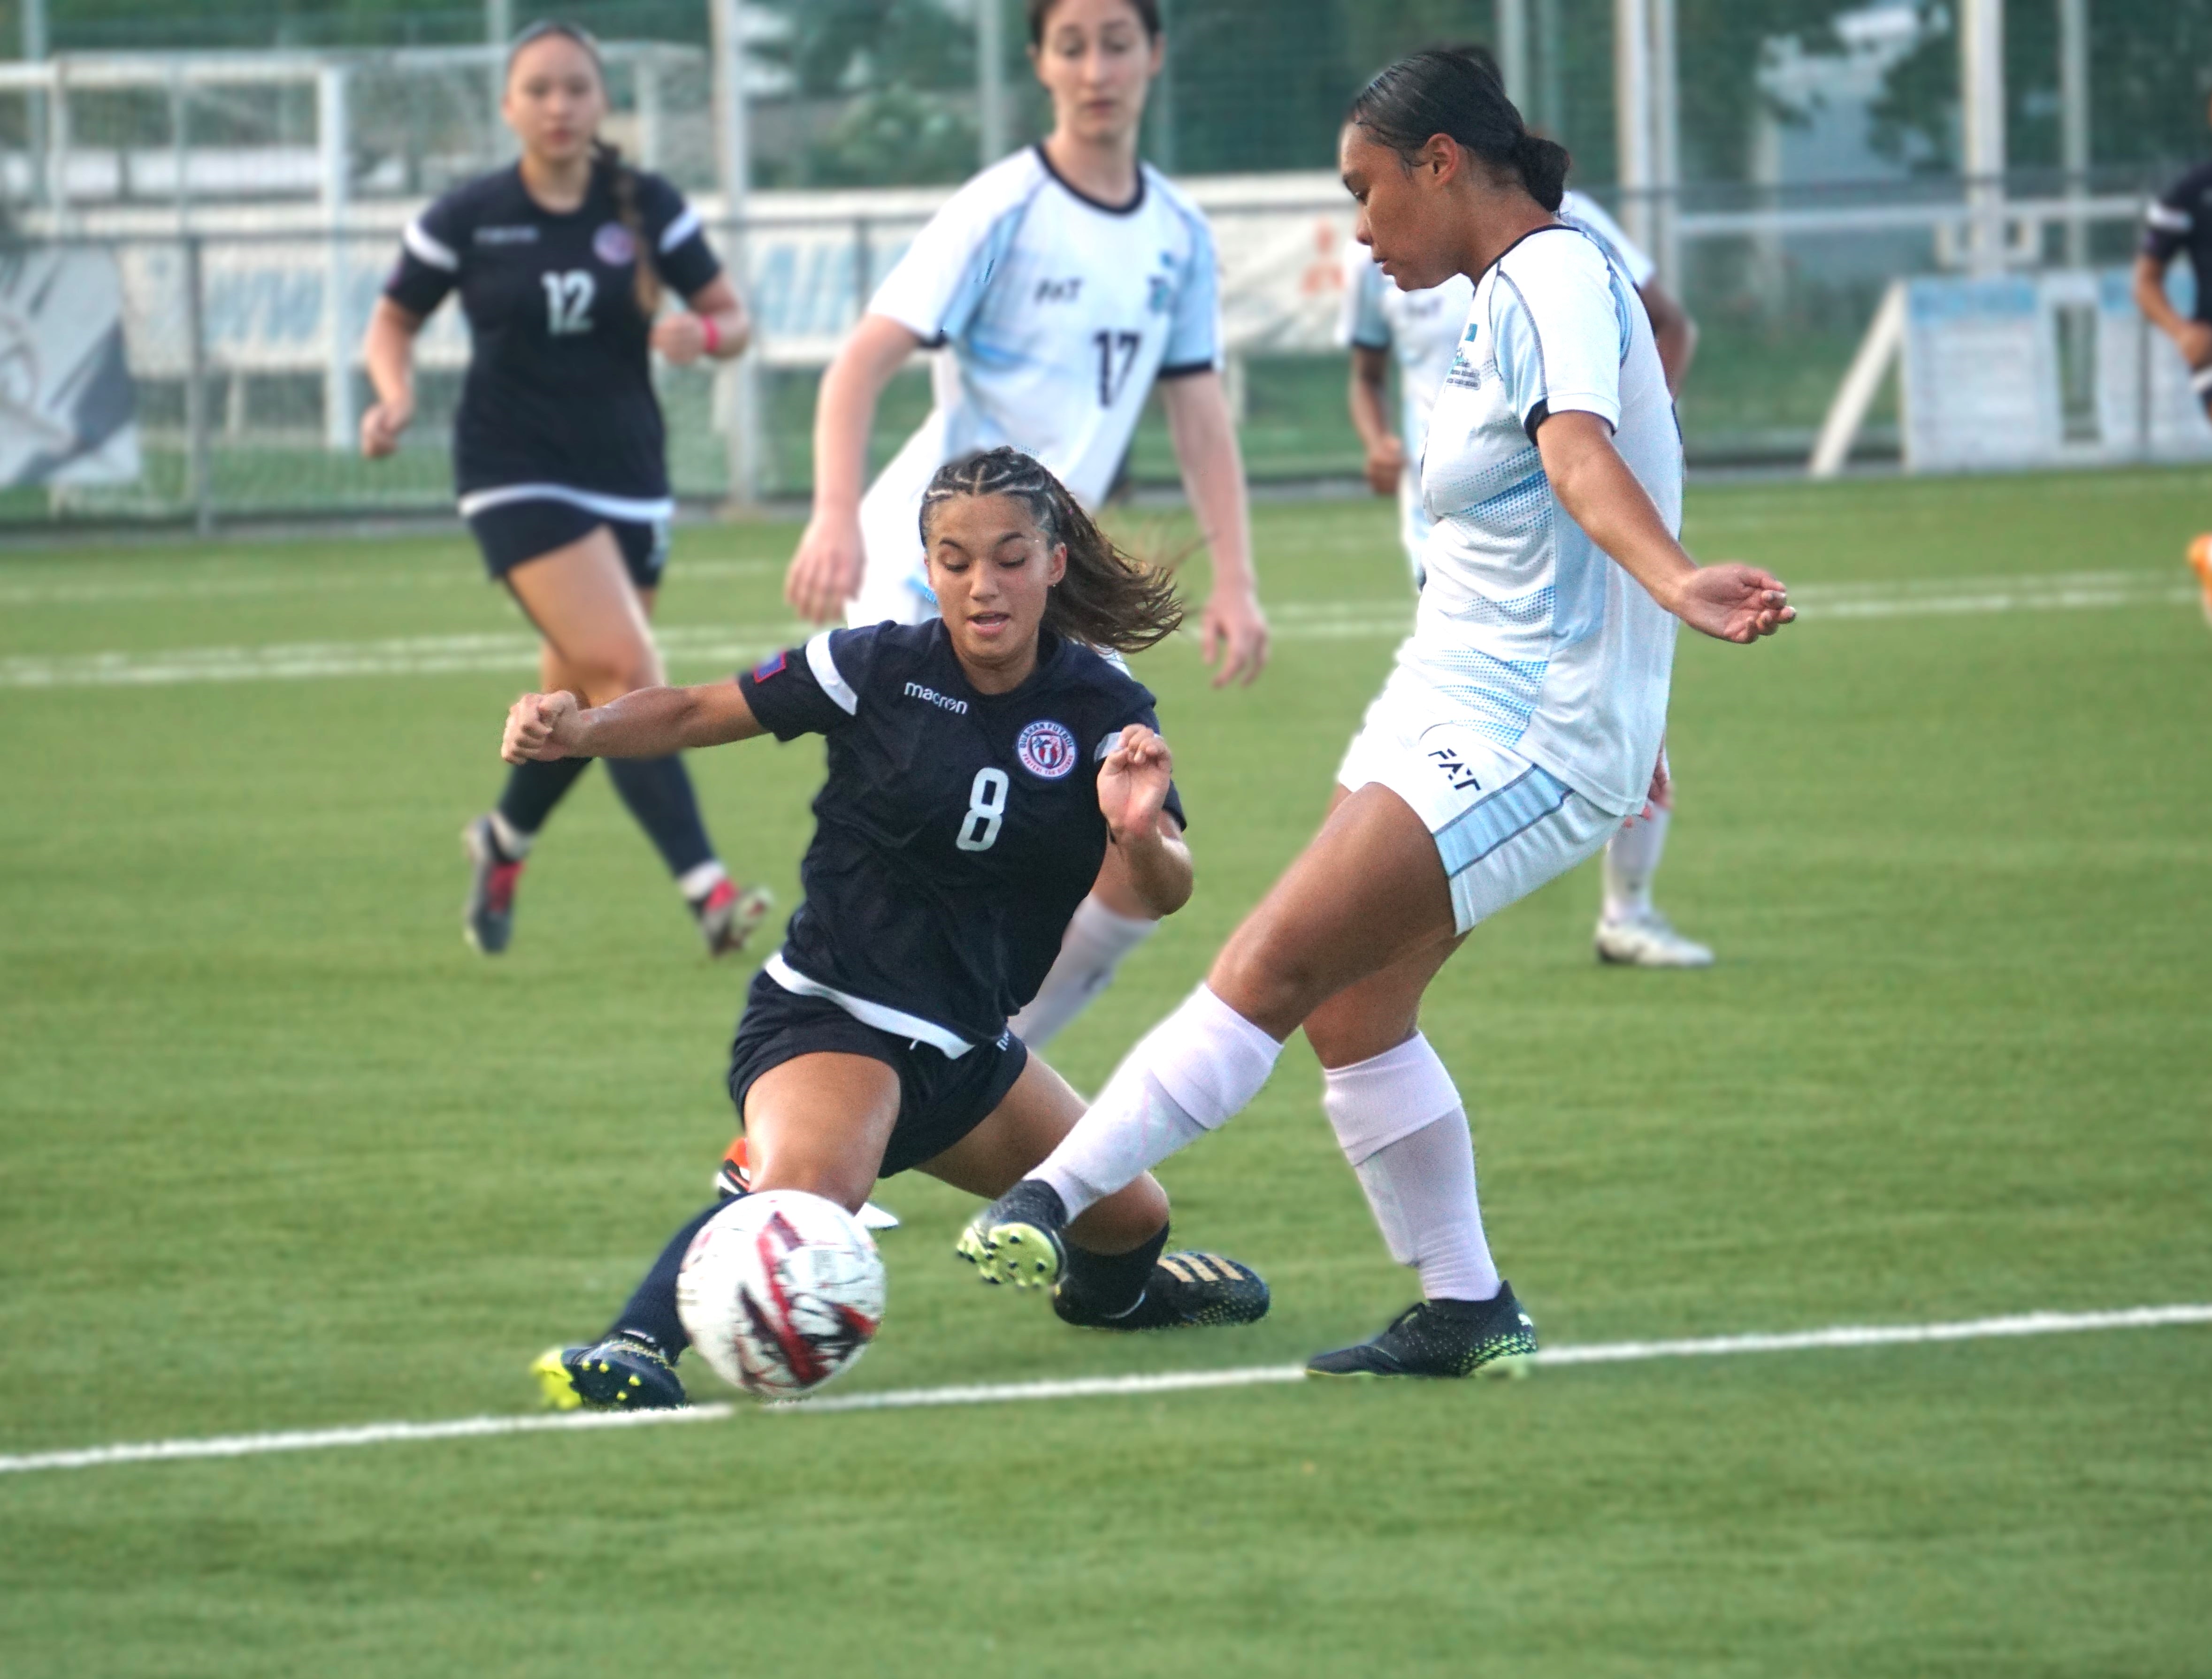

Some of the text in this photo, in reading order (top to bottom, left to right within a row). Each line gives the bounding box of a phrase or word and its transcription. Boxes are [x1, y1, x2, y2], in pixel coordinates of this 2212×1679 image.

[542, 270, 595, 335] 12
[1094, 328, 1142, 408] 17
[904, 682, 968, 715] macron
[1427, 748, 1482, 791] FAT
[956, 767, 1009, 851] 8
